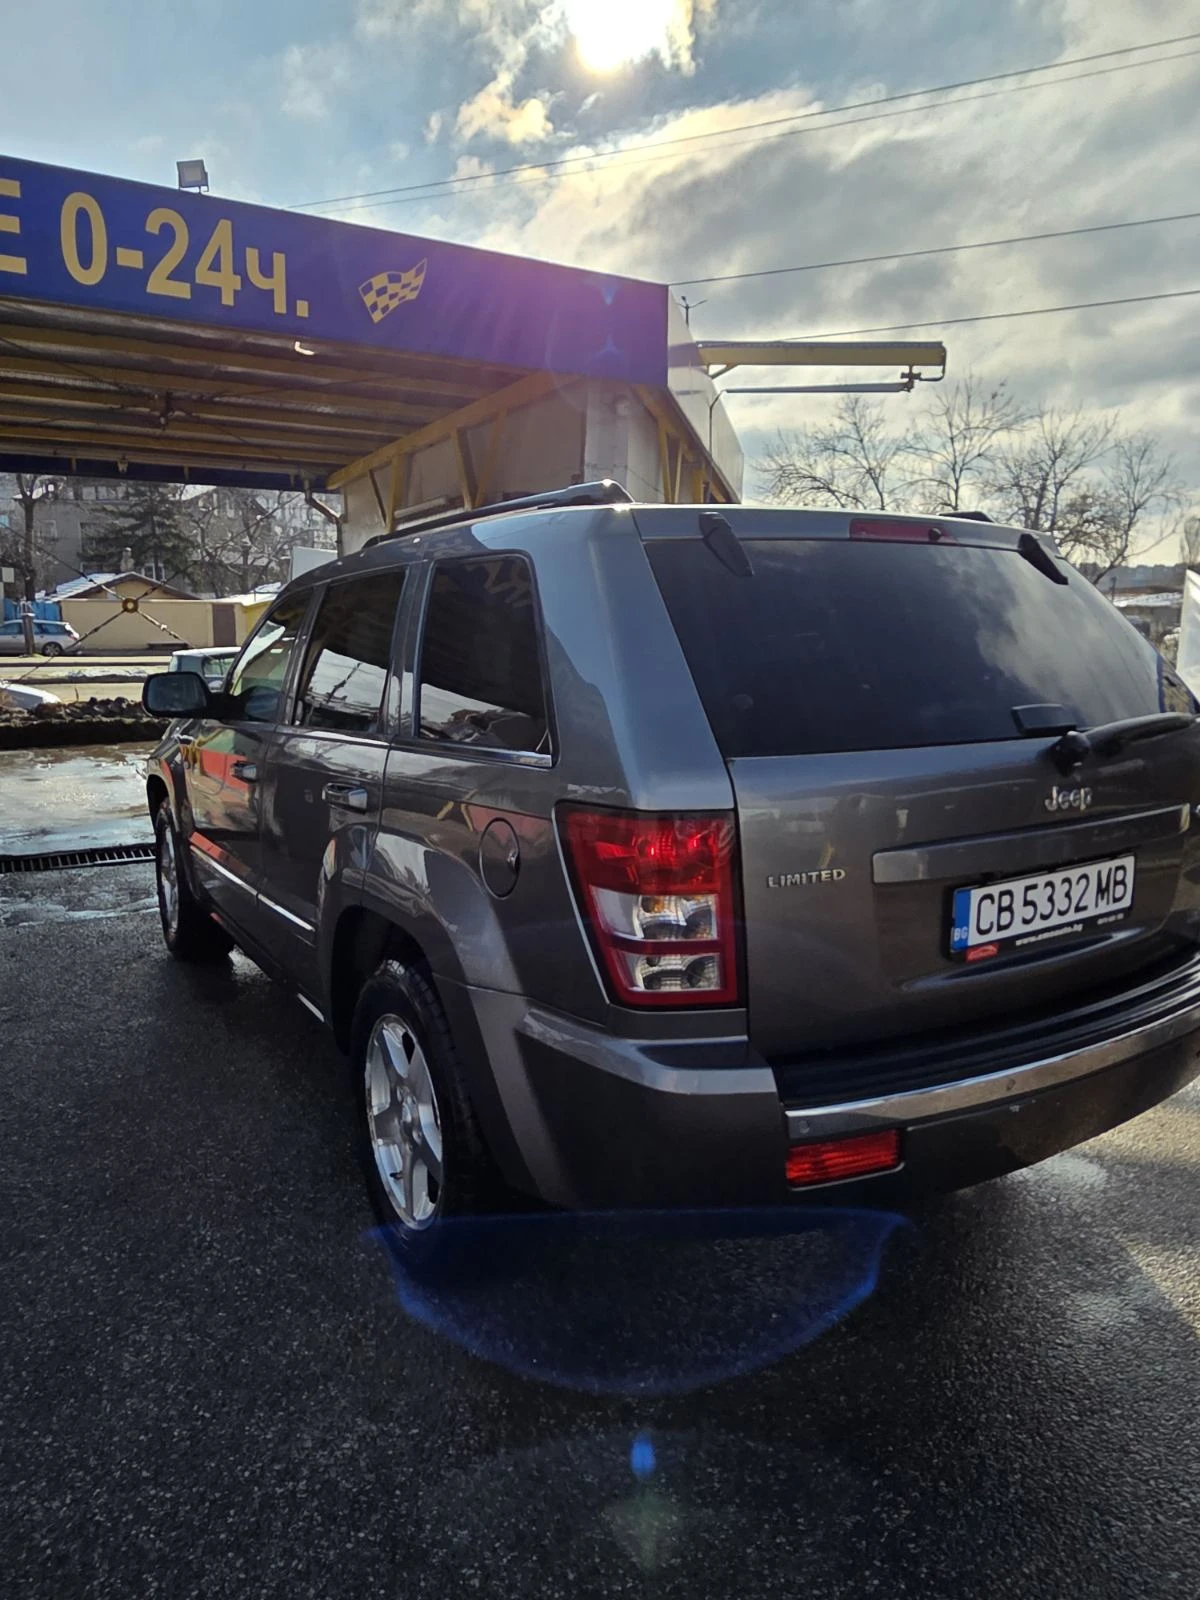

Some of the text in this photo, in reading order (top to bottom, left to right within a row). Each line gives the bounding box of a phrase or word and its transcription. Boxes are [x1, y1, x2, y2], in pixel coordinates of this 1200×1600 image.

[1044, 786, 1092, 811] Jeep
[767, 868, 846, 888] LIMITED
[953, 926, 968, 942] BG
